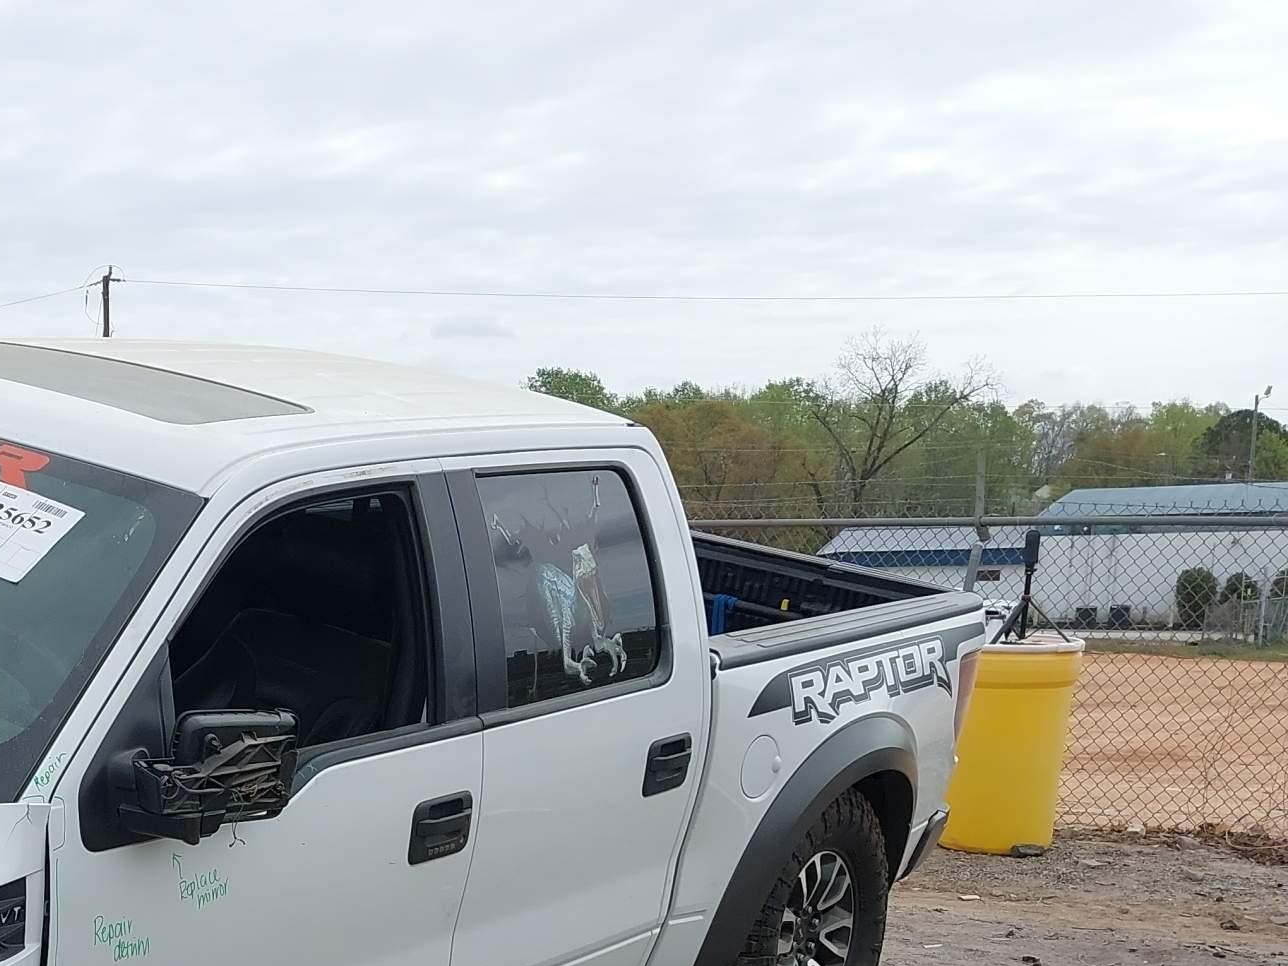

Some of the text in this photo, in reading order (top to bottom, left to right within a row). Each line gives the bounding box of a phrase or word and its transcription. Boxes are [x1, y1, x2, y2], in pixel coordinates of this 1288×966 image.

[789, 637, 952, 725] RAPTOR
[34, 752, 67, 792] Repair
[94, 915, 133, 946] Repair
